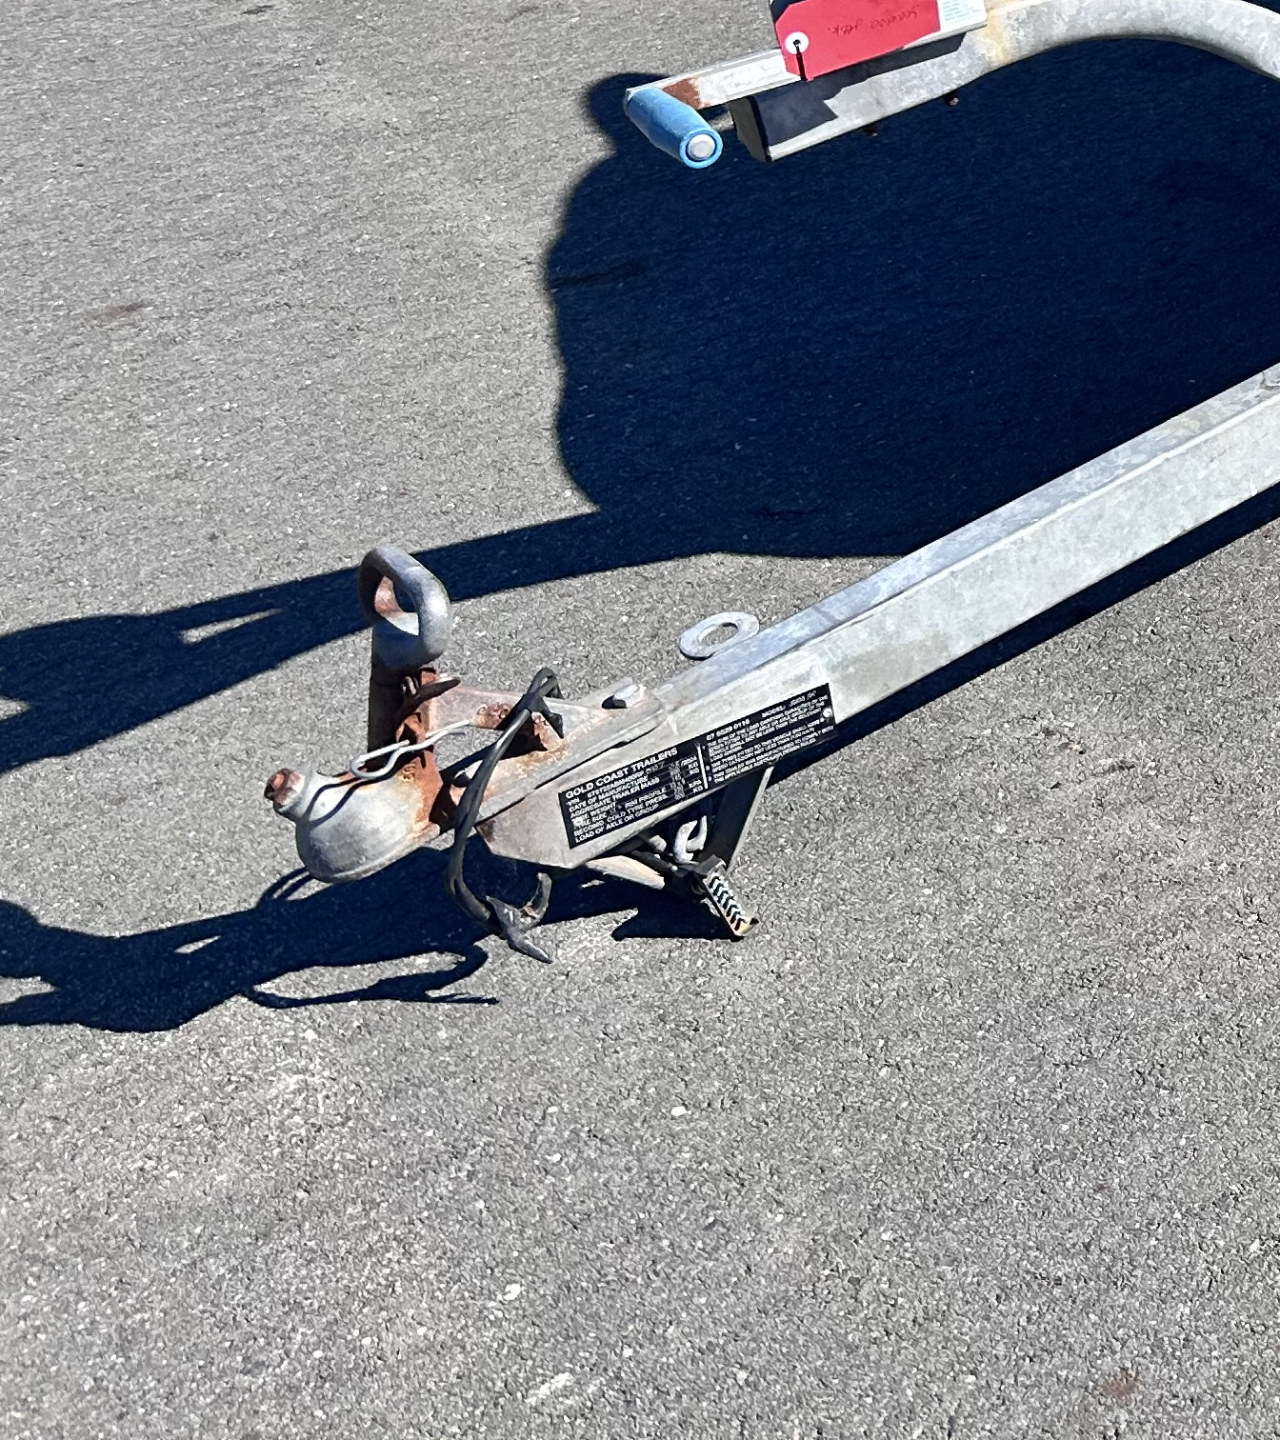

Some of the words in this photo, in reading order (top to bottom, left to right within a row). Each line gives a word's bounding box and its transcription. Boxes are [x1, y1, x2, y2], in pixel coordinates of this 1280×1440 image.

[566, 782, 594, 799] GOLD
[596, 768, 628, 786] COAST
[631, 748, 678, 772] TRAILERS
